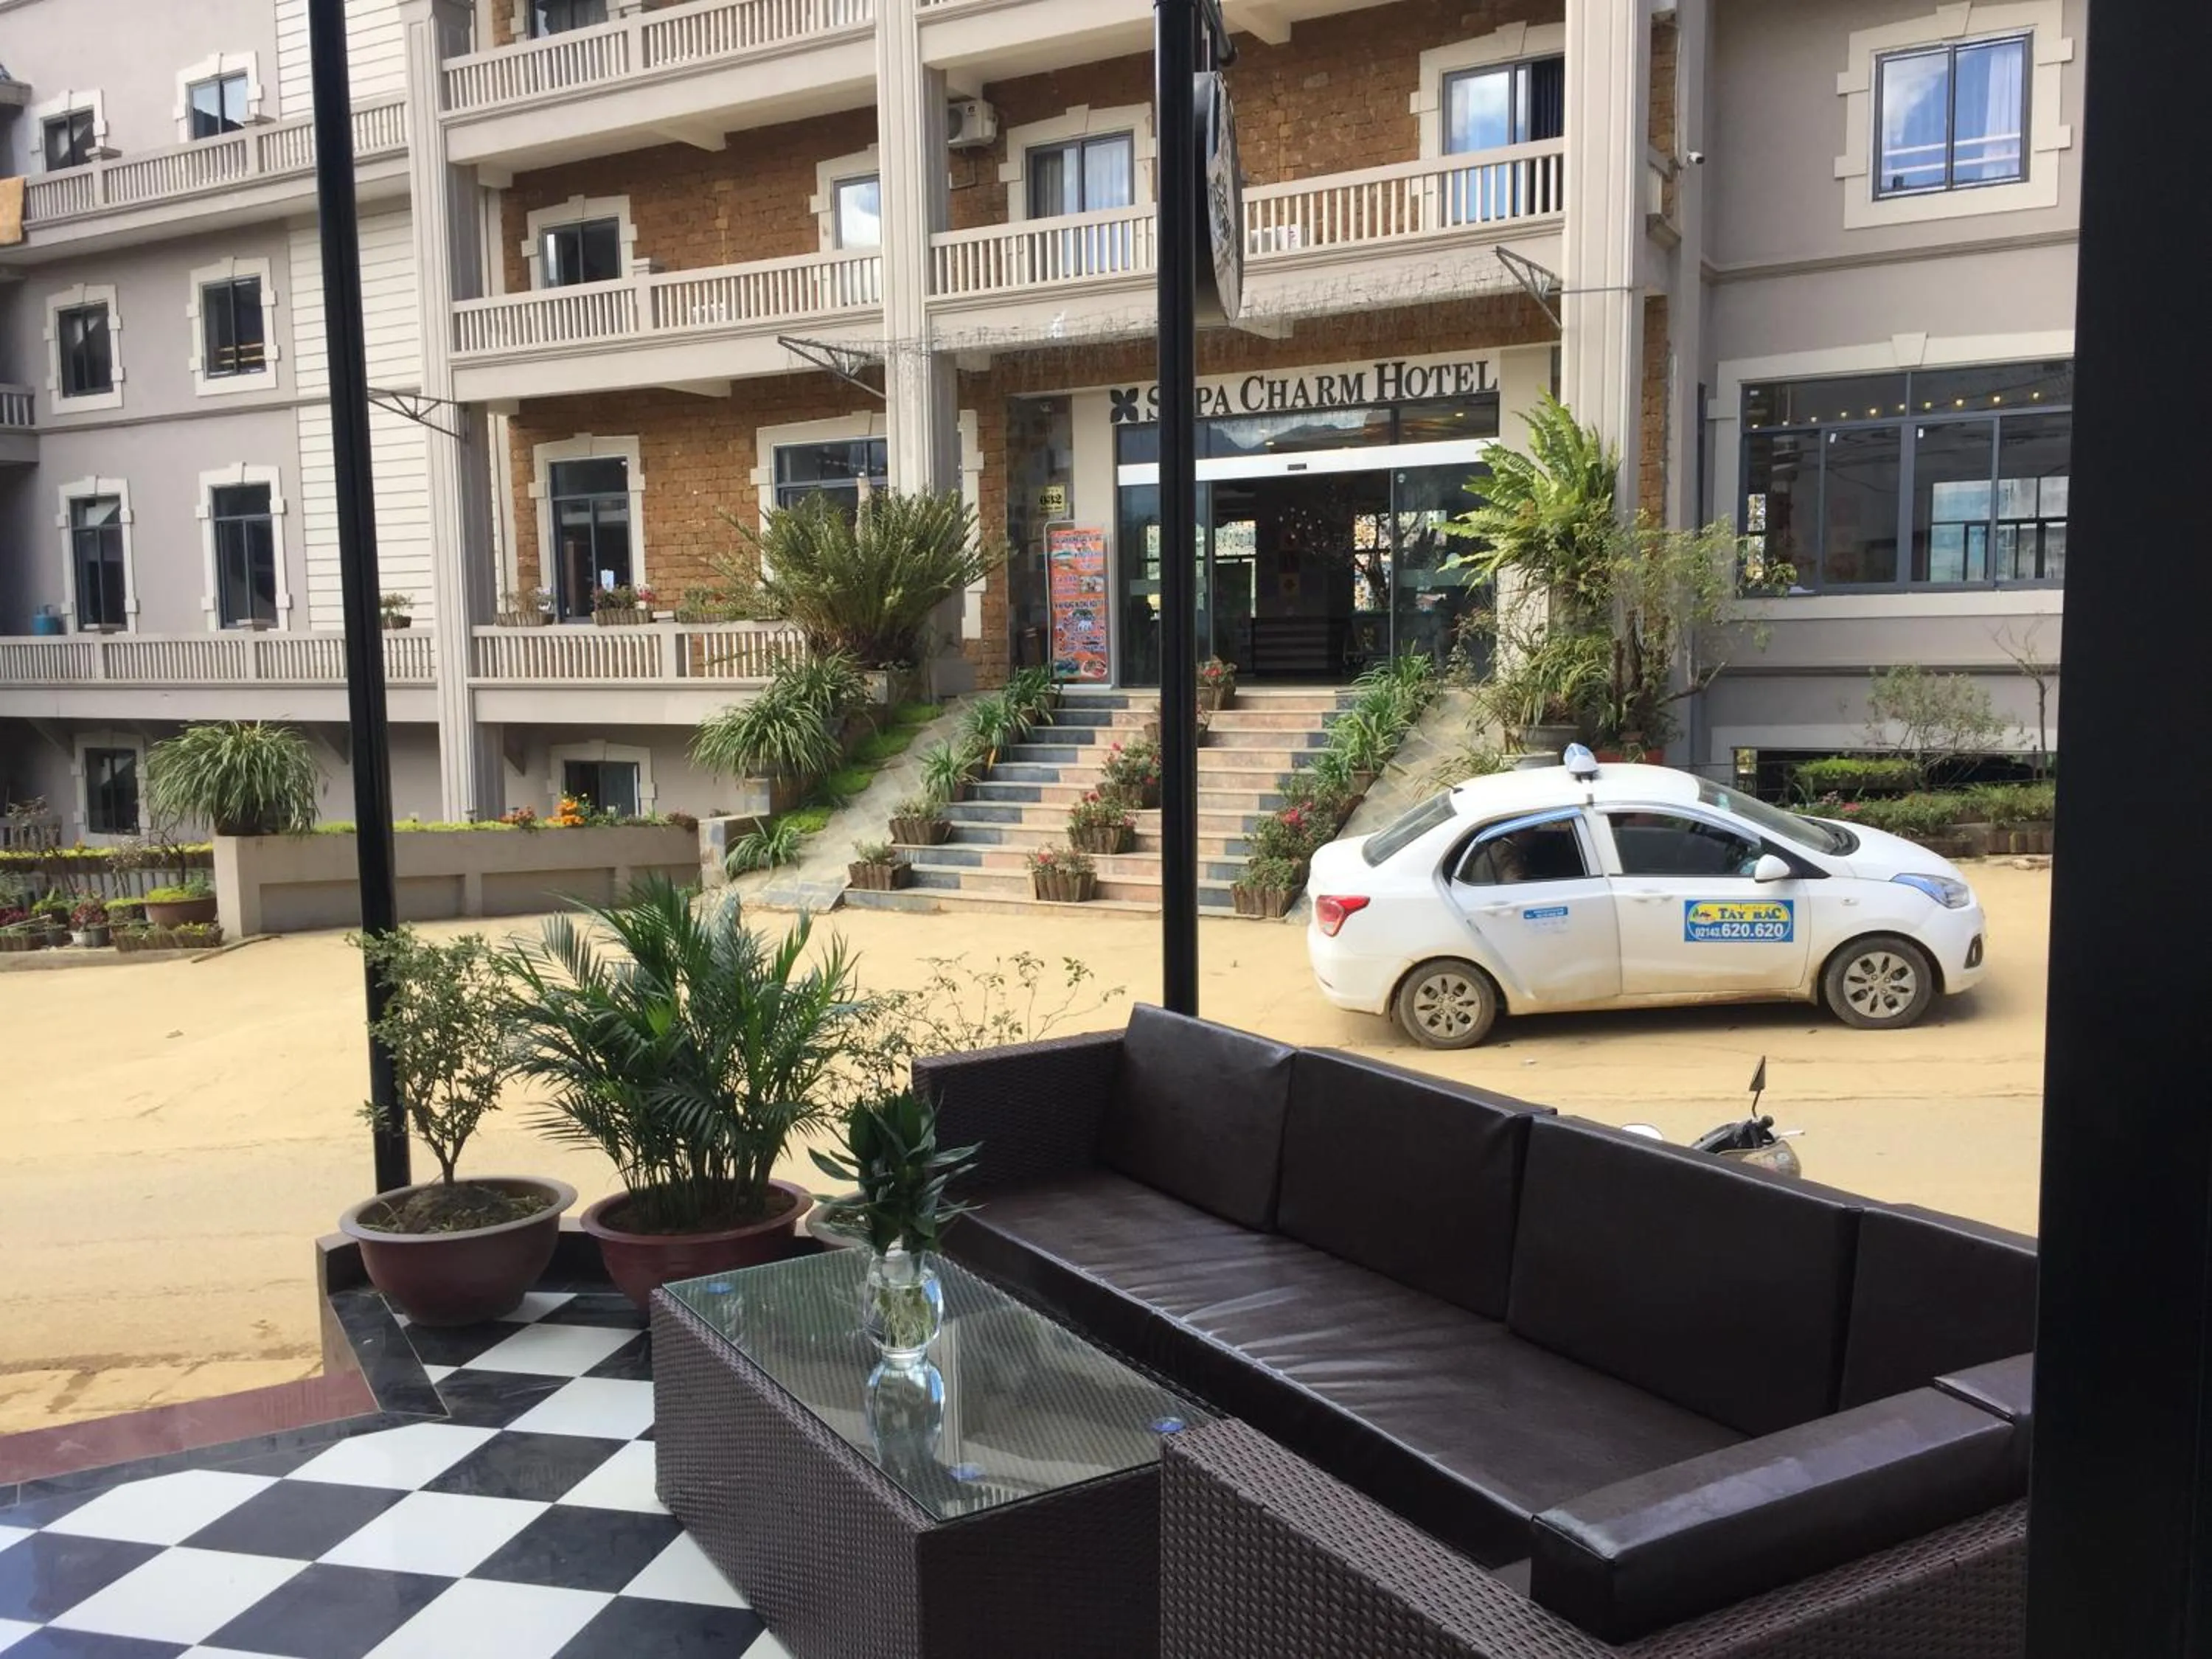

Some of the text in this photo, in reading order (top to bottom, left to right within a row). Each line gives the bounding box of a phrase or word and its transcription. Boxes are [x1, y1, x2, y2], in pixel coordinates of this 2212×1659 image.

[1147, 360, 1498, 421] SPA CHARM HOTEL
